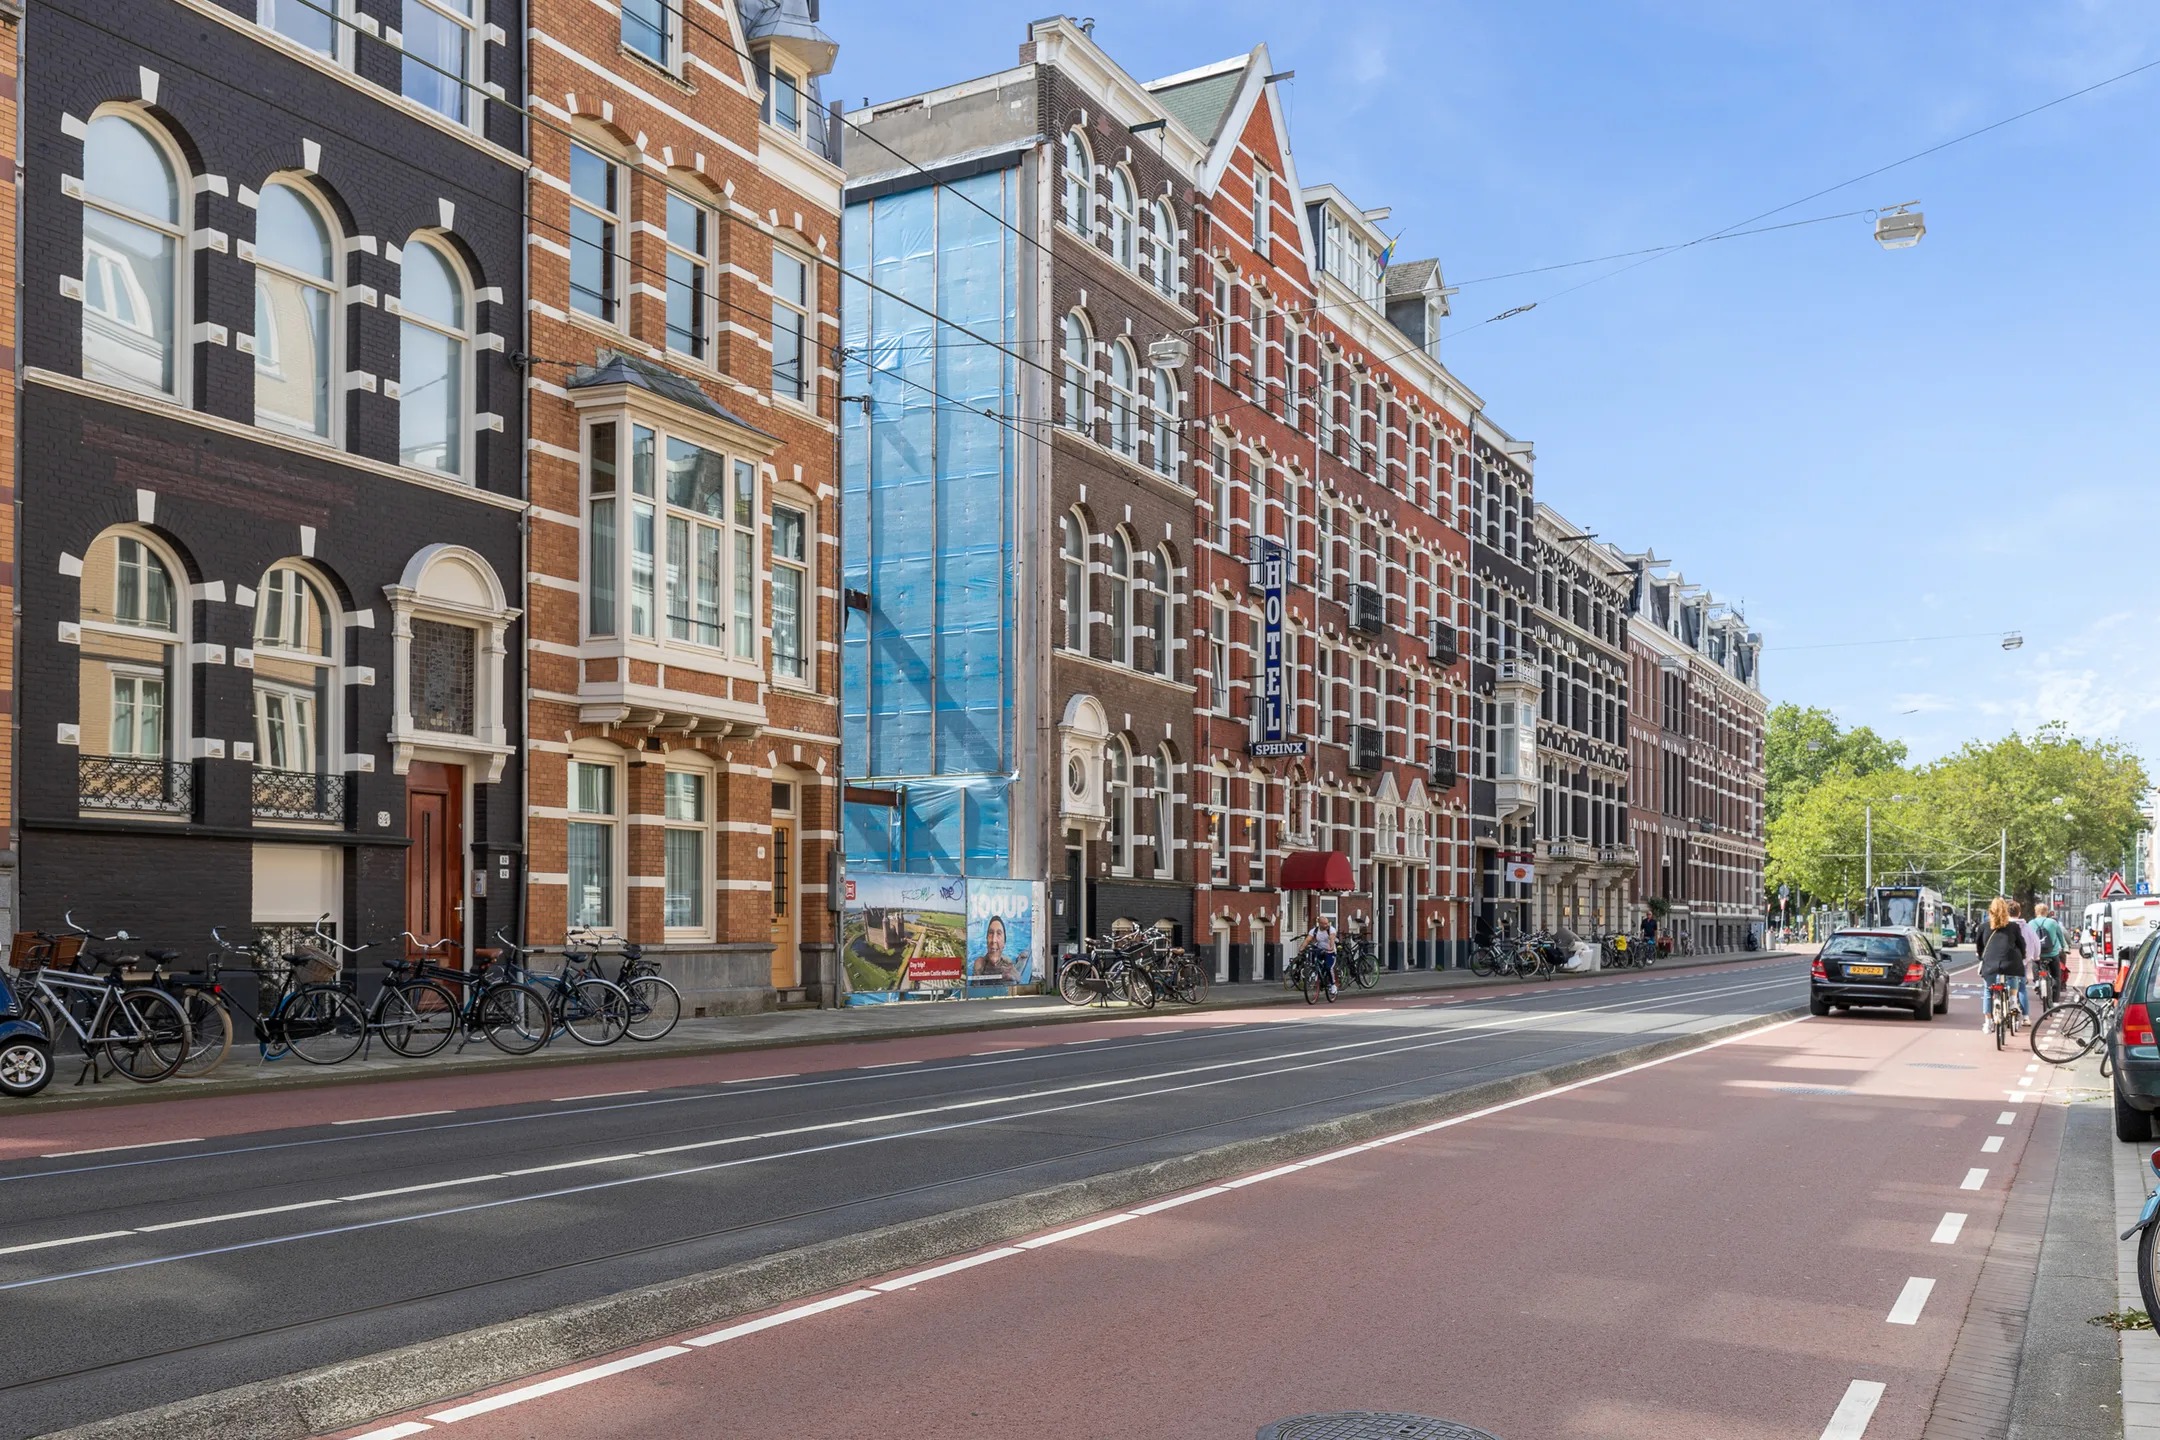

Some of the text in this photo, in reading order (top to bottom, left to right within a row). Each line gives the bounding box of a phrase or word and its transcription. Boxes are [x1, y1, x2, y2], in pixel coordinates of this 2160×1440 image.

[1266, 559, 1281, 732] HOTEL
[1255, 742, 1304, 755] SPHINX
[909, 961, 918, 969] Day
